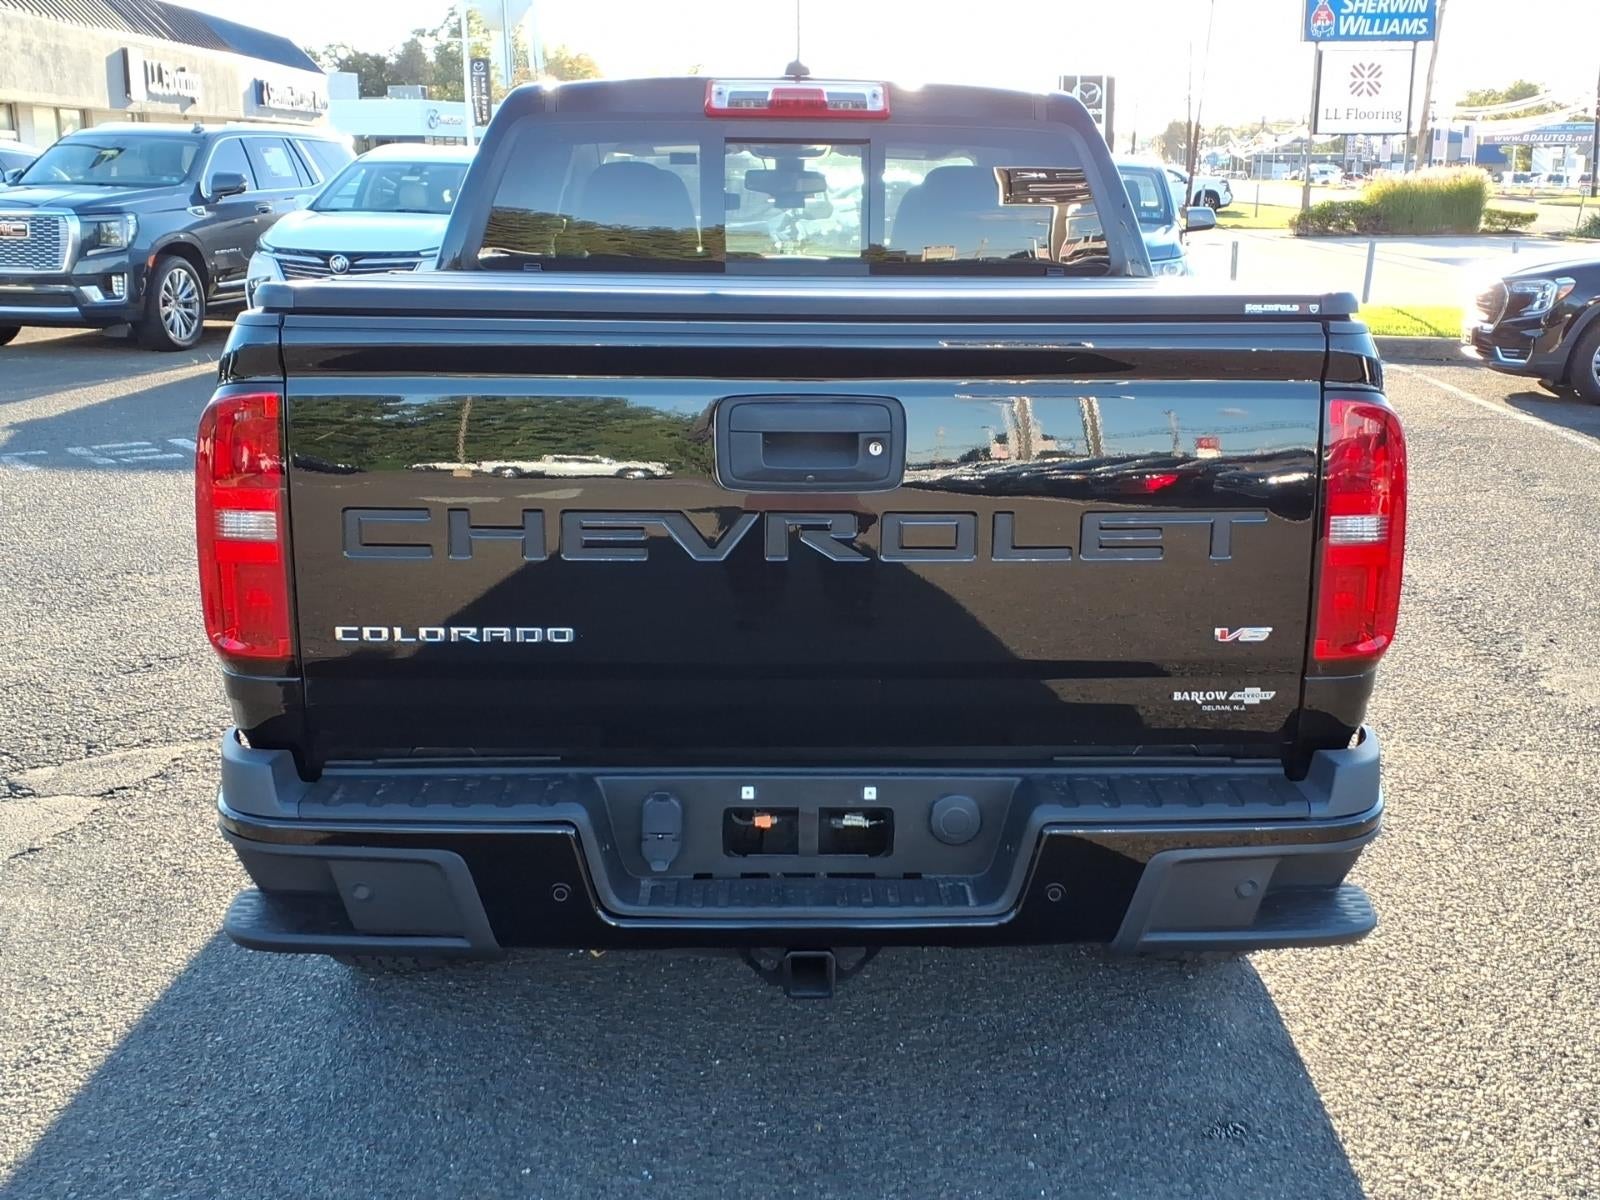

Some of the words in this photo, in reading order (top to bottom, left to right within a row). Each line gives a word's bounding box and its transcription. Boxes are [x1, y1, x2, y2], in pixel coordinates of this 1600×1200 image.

[1341, 0, 1429, 14] SHERWIN
[1339, 15, 1429, 36] WILLIAMS
[1325, 108, 1341, 119] LL
[1346, 108, 1402, 123] Flooring
[342, 507, 1268, 562] CHEVROLET
[334, 626, 575, 643] COLORADO
[1214, 627, 1273, 642] V6
[1173, 691, 1227, 704] BARLOW
